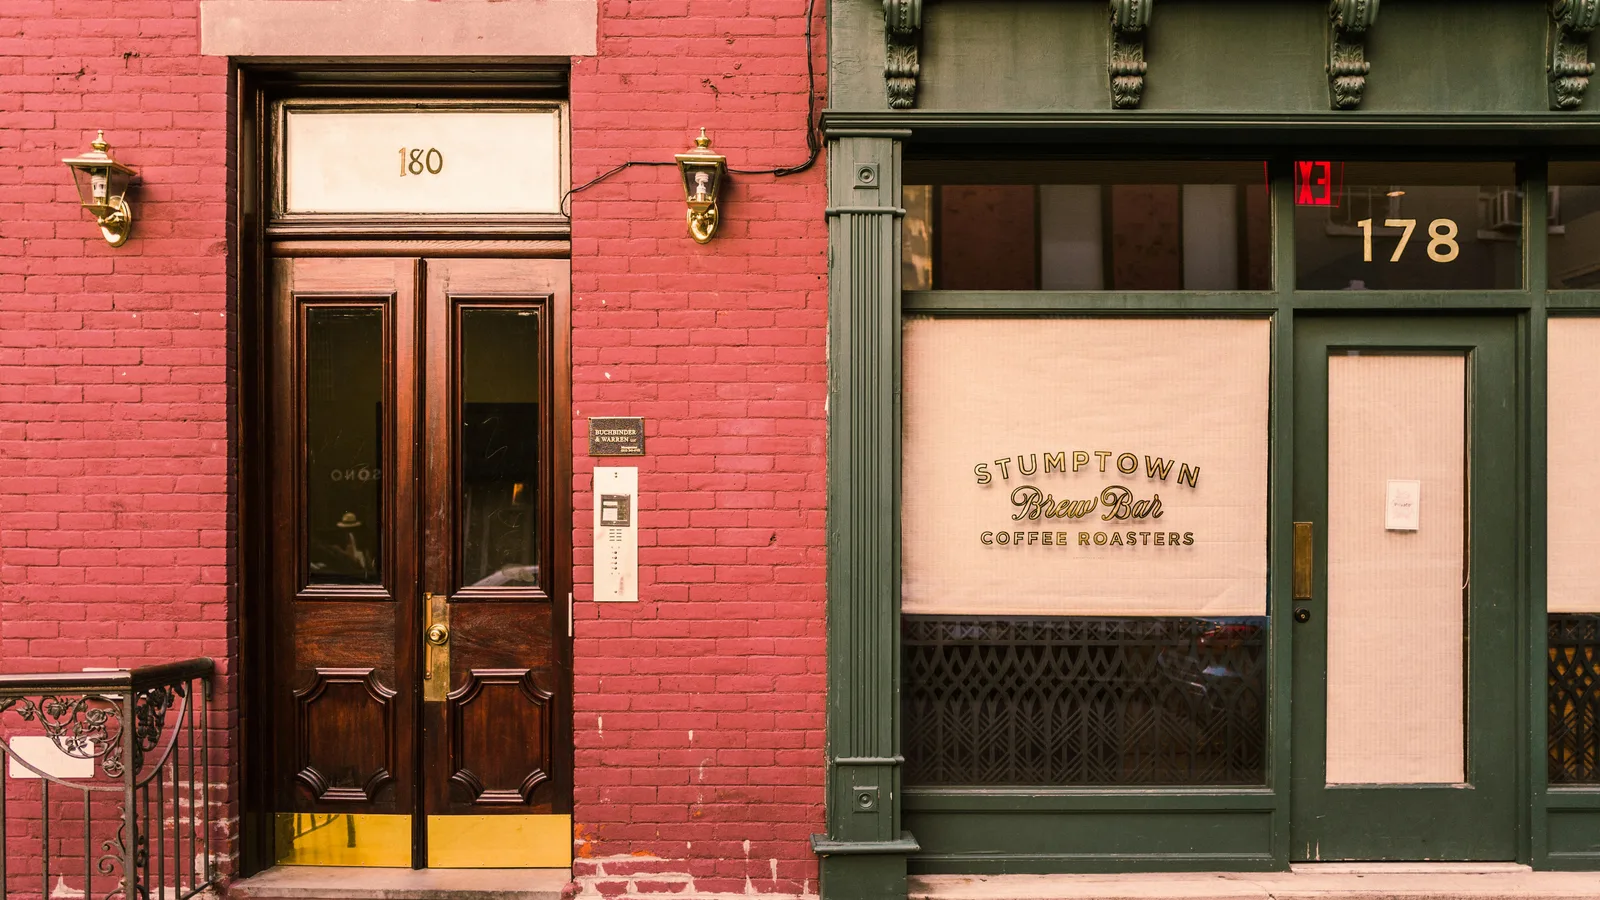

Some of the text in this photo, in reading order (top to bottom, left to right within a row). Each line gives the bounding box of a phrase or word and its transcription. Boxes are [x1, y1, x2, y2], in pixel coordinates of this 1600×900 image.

[399, 147, 443, 177] 180
[1357, 218, 1460, 263] 178
[974, 451, 1201, 488] STUMPTOWN
[1010, 485, 1164, 521] Brew Bar
[980, 530, 1195, 546] COFFEE ROASTERS
